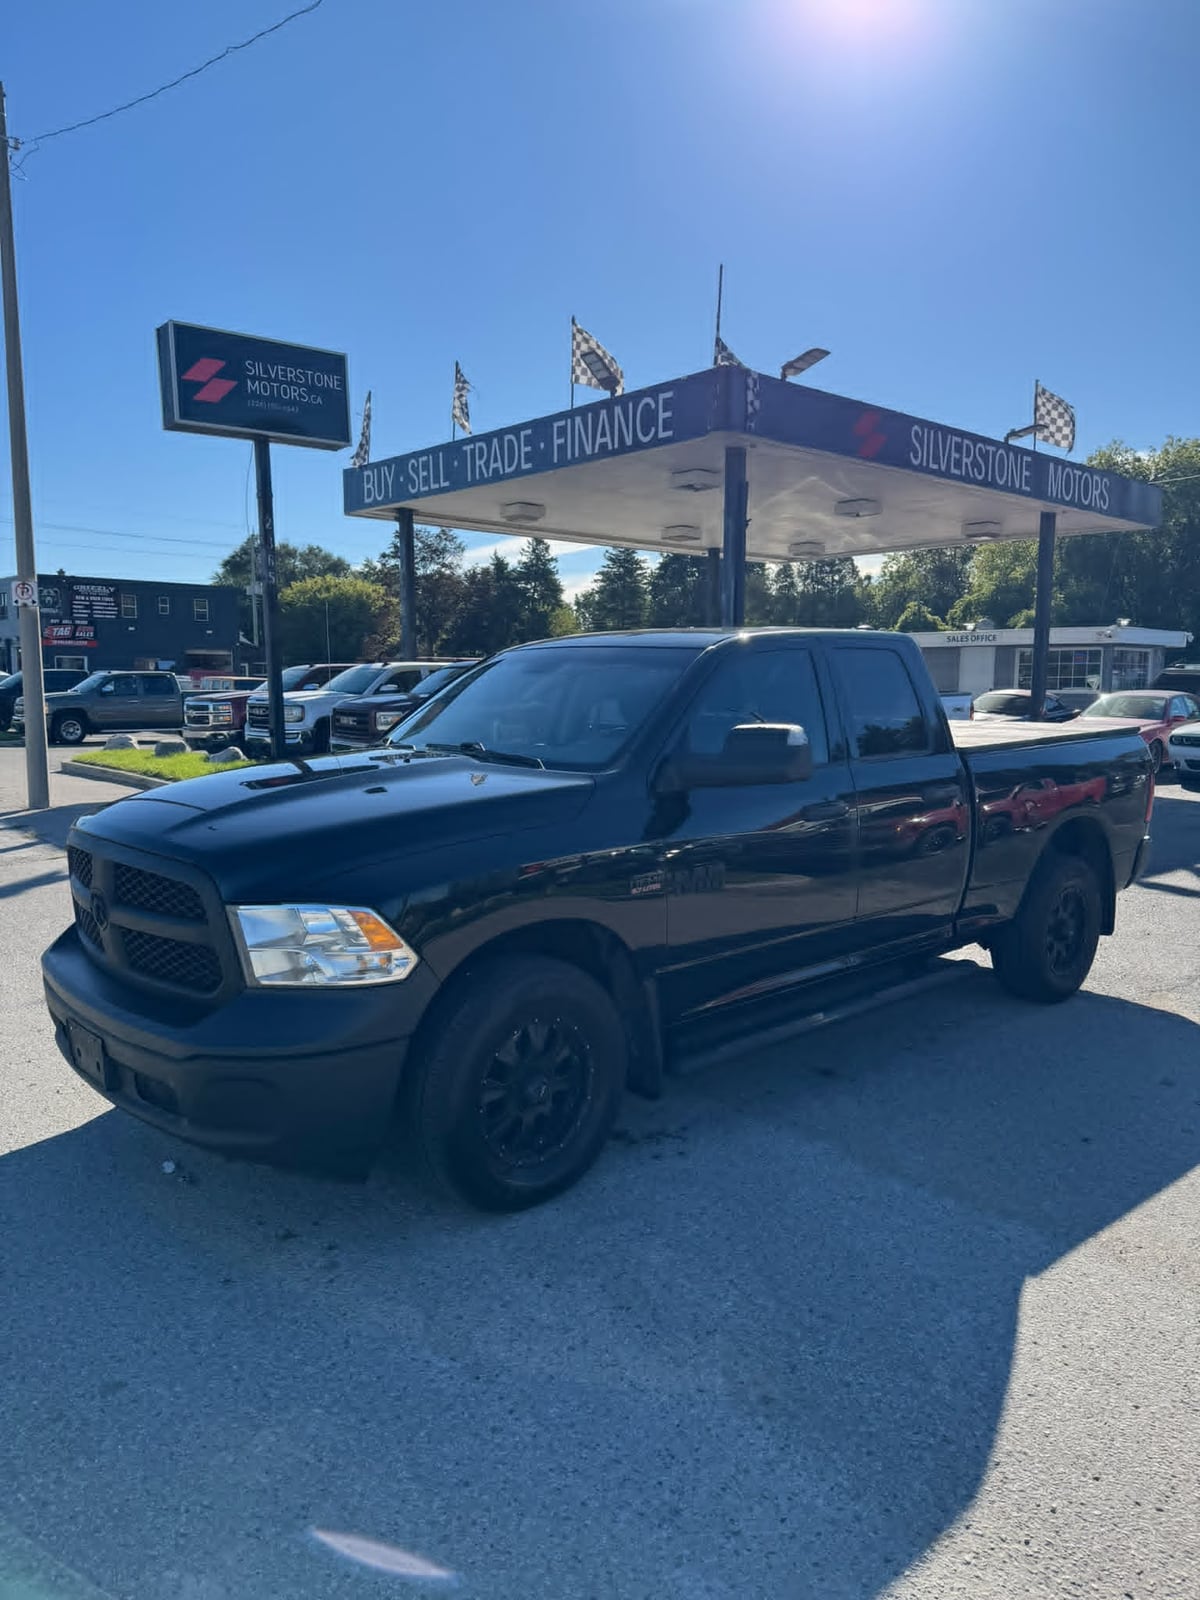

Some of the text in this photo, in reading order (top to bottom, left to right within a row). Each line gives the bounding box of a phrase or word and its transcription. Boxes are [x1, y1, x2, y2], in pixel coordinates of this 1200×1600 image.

[245, 360, 343, 391] SILVERSTONE
[247, 378, 323, 405] MOTORS.CA
[363, 391, 674, 503] BUY SELL TRADE FINANCE
[909, 424, 1111, 511] SILVERSTONE MOTORS
[53, 627, 71, 636] TAG
[946, 633, 998, 643] SALES OFFICE
